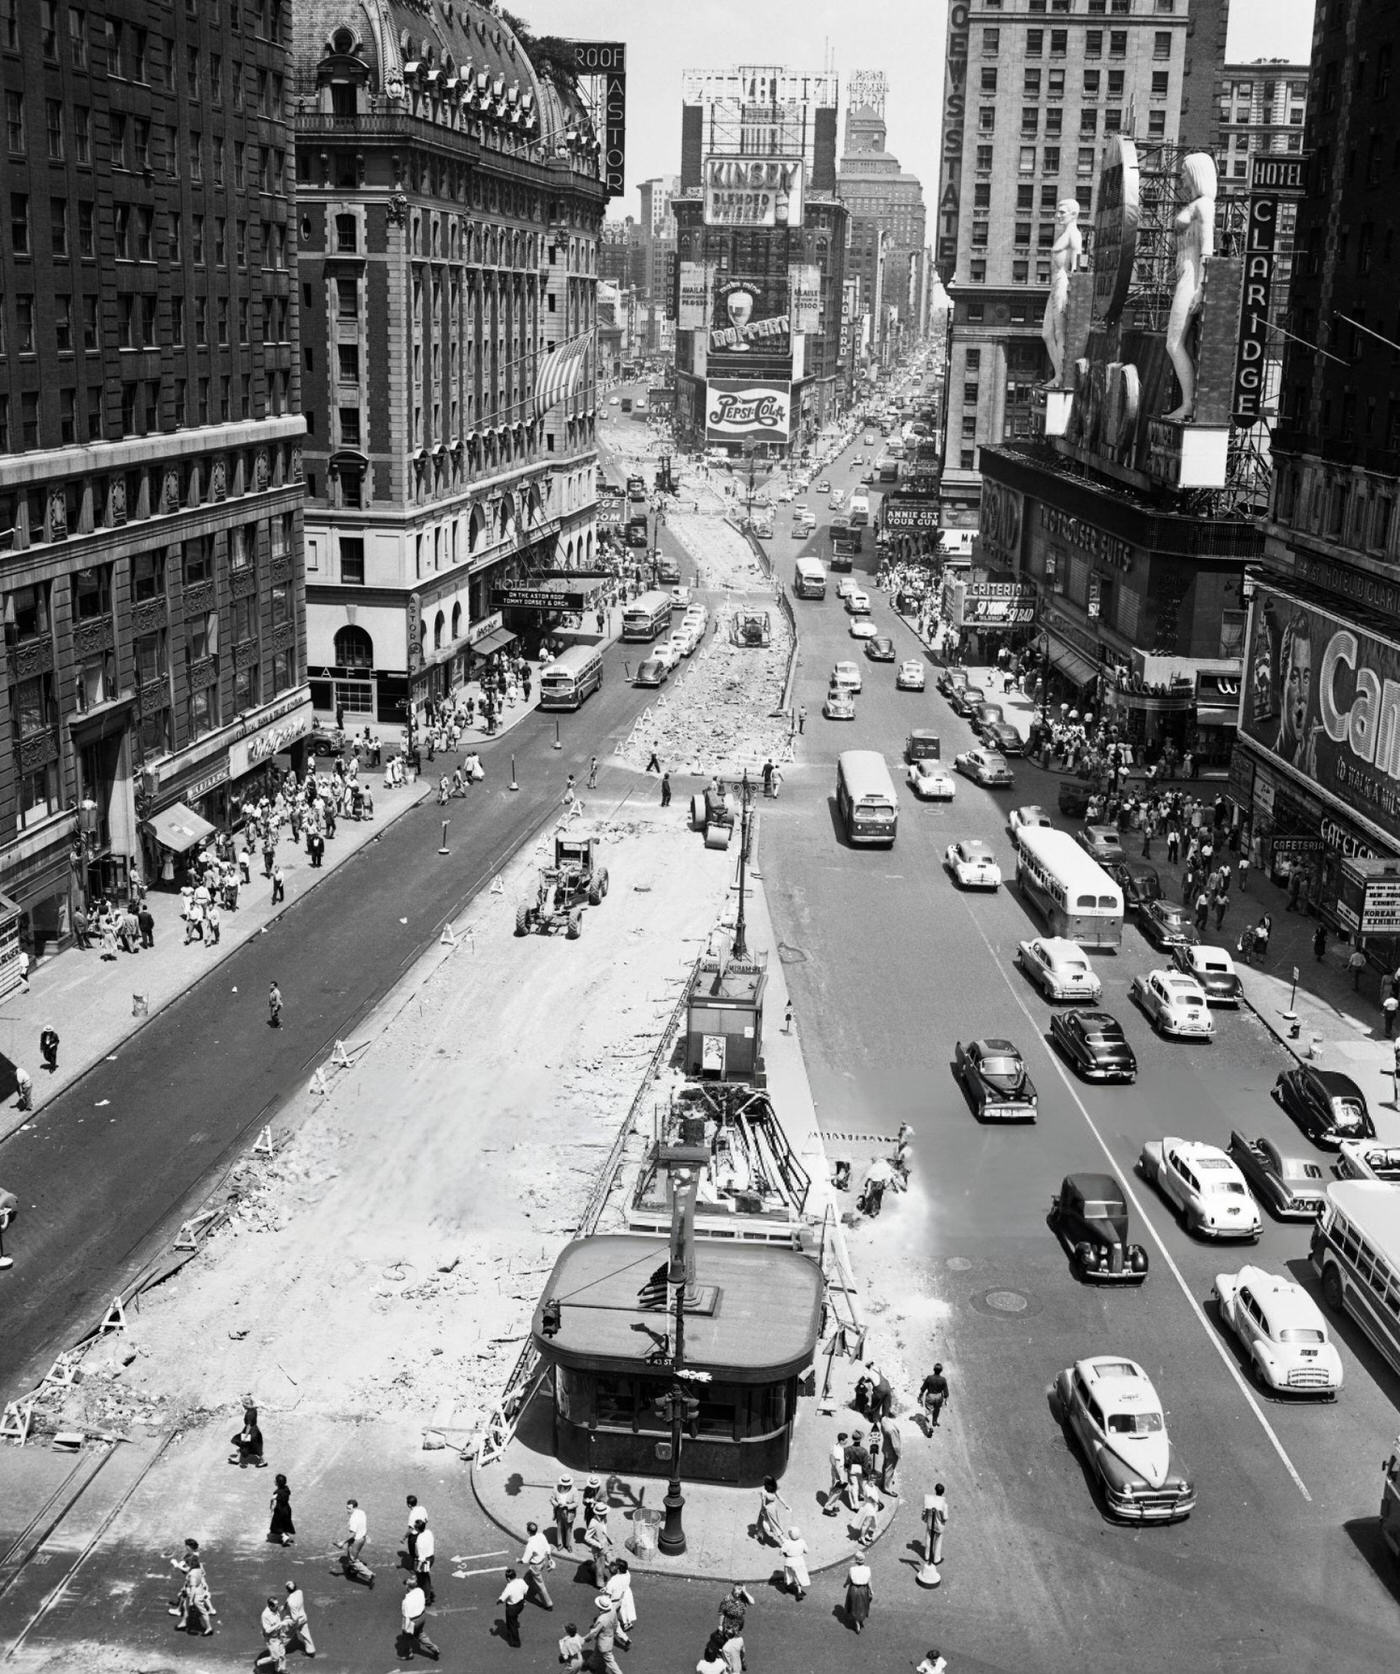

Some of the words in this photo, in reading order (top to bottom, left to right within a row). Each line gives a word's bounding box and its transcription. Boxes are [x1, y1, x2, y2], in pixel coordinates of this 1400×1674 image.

[574, 48, 624, 67] ROOF
[946, 0, 969, 116] OEW'S
[606, 79, 624, 191] ASTOR
[1254, 161, 1304, 188] HOTEL
[713, 193, 770, 206] BLENDED
[938, 130, 963, 259] STATE
[1238, 201, 1272, 415] CLARIDGE
[712, 315, 789, 347] RUPPERT
[840, 295, 849, 357] HOWARD
[888, 511, 918, 519] ANNIE
[1101, 534, 1132, 572] SUITS
[494, 578, 529, 590] HOTEL
[972, 583, 1032, 595] CRITERION
[409, 596, 417, 640] ASTOR
[975, 601, 987, 615] SO
[1006, 608, 1018, 622] SO
[1017, 608, 1034, 622] BAD
[1273, 840, 1325, 851] CAFETERIA
